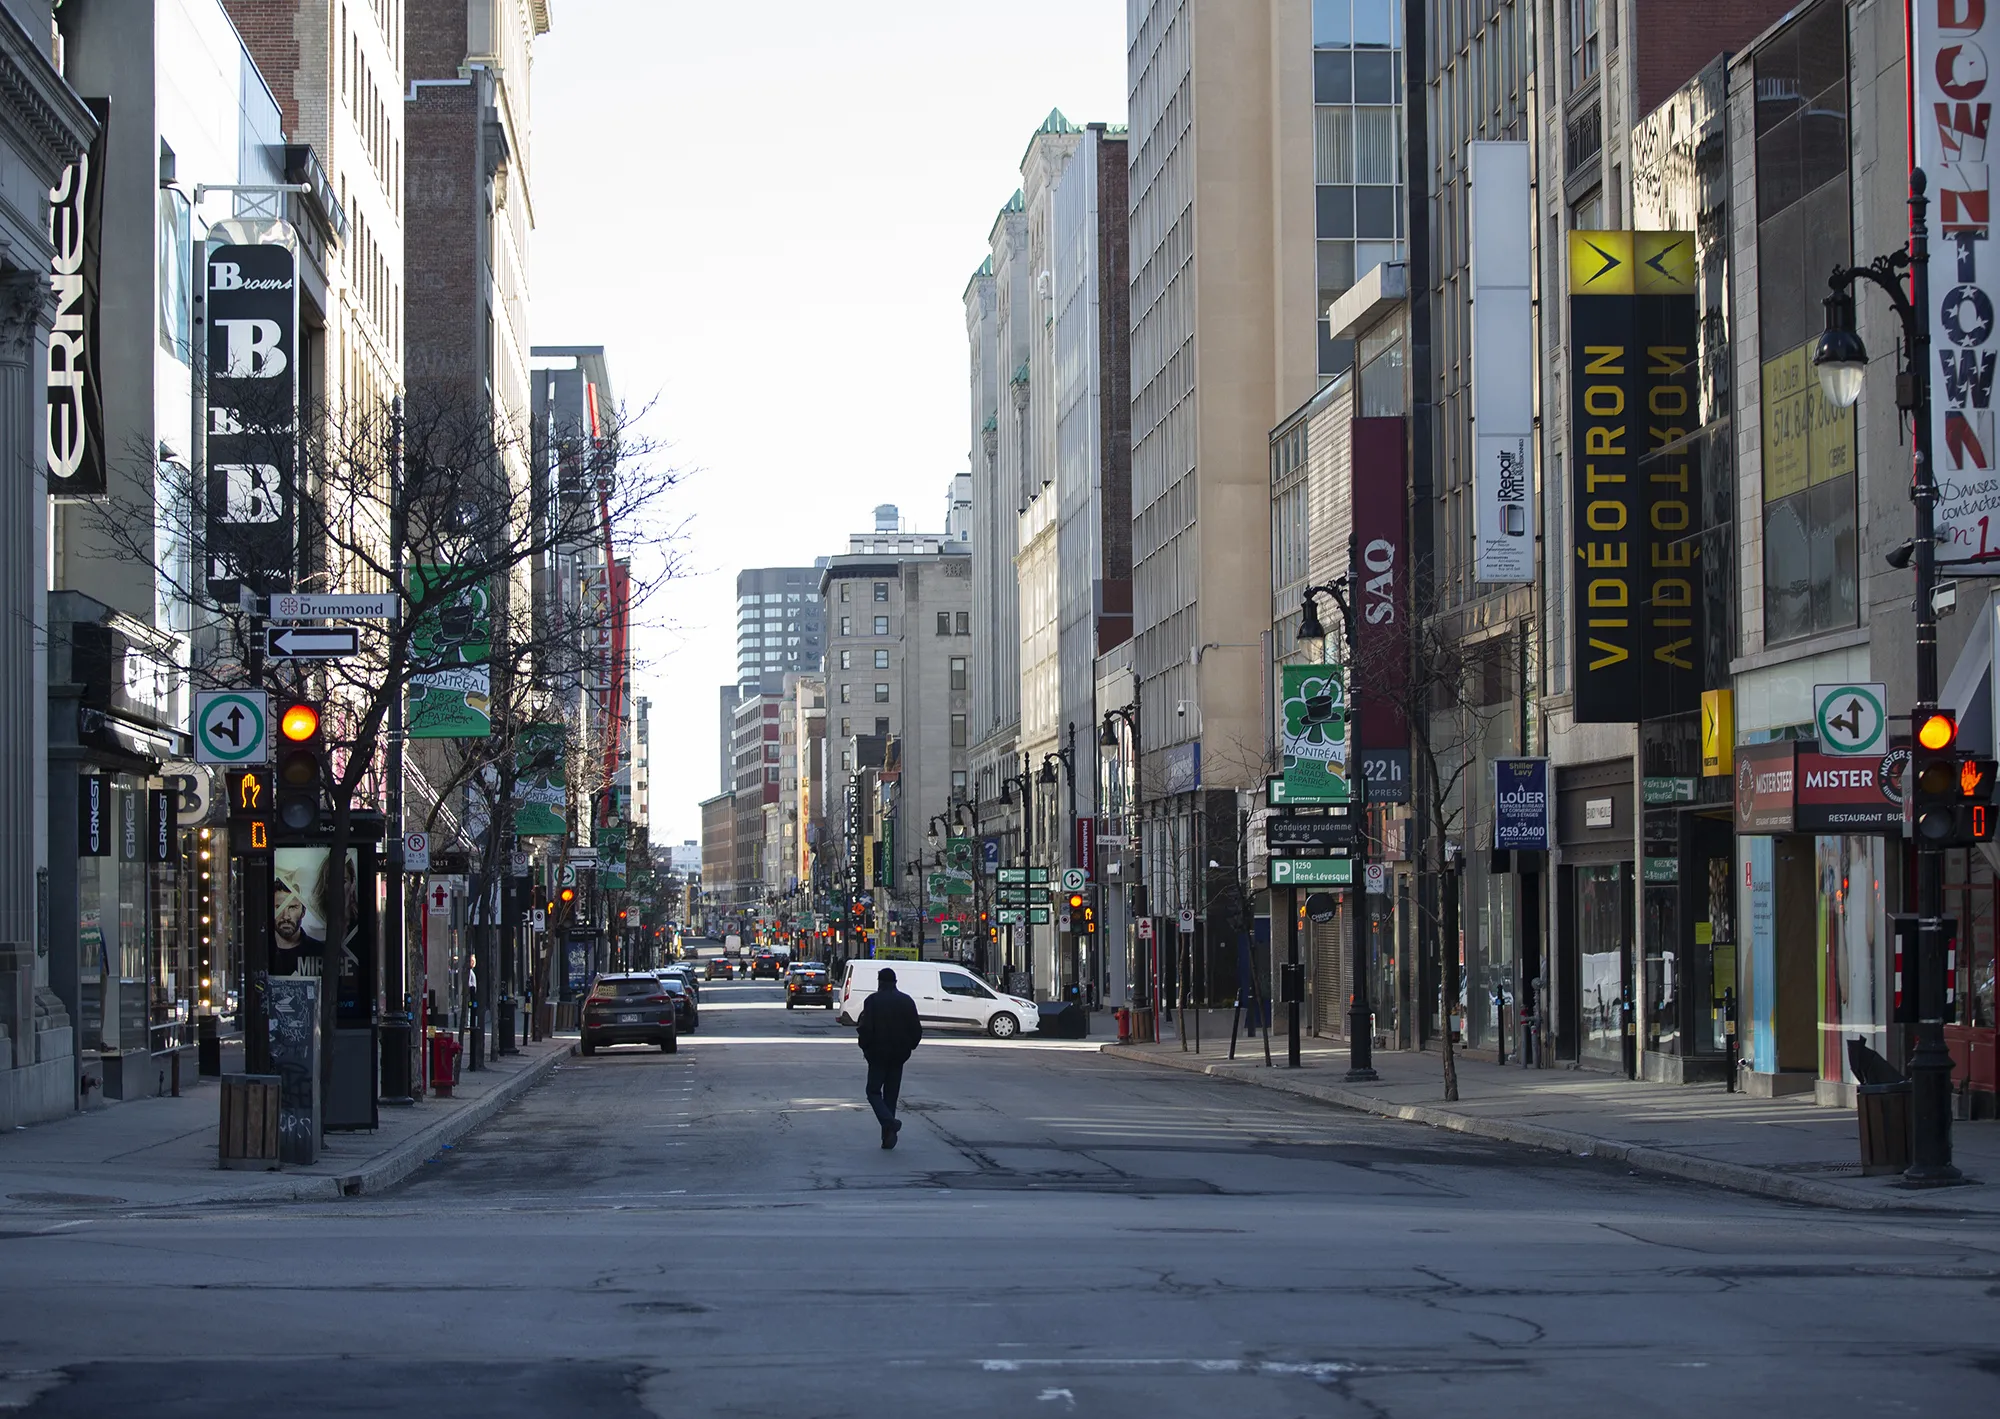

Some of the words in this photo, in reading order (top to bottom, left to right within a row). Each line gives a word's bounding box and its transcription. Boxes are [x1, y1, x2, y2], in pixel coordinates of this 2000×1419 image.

[209, 262, 293, 291] Browns
[48, 153, 89, 478] ERNES
[214, 319, 288, 379] B
[1497, 450, 1514, 502] iRepair
[1512, 477, 1525, 502] MTL
[1937, 477, 1999, 507] Danses
[1577, 345, 1629, 671] VIDÉOTRON
[1364, 538, 1396, 625] SAQ
[300, 602, 384, 616] Drummond
[1284, 744, 1343, 762] MONTRÉAL
[1880, 750, 1905, 777] MISTER
[1294, 768, 1326, 779] PARADE
[1300, 760, 1321, 770] 1824
[1363, 760, 1387, 782] 22
[1514, 769, 1532, 777] Lavy
[1775, 770, 1793, 793] STEER
[1805, 770, 1873, 788] MISTER
[1368, 789, 1403, 797] XPRESS
[1500, 792, 1544, 804] LOUER
[90, 778, 100, 853] ERNEST
[158, 792, 168, 859] ERNEST
[1828, 813, 1882, 823] RESTAURANT
[1274, 823, 1311, 831] Conduisez
[1312, 823, 1352, 832] prudemme
[1500, 827, 1545, 837] 259.2400
[1296, 872, 1350, 882] René-Lévesque
[298, 956, 354, 977] MIRGE
